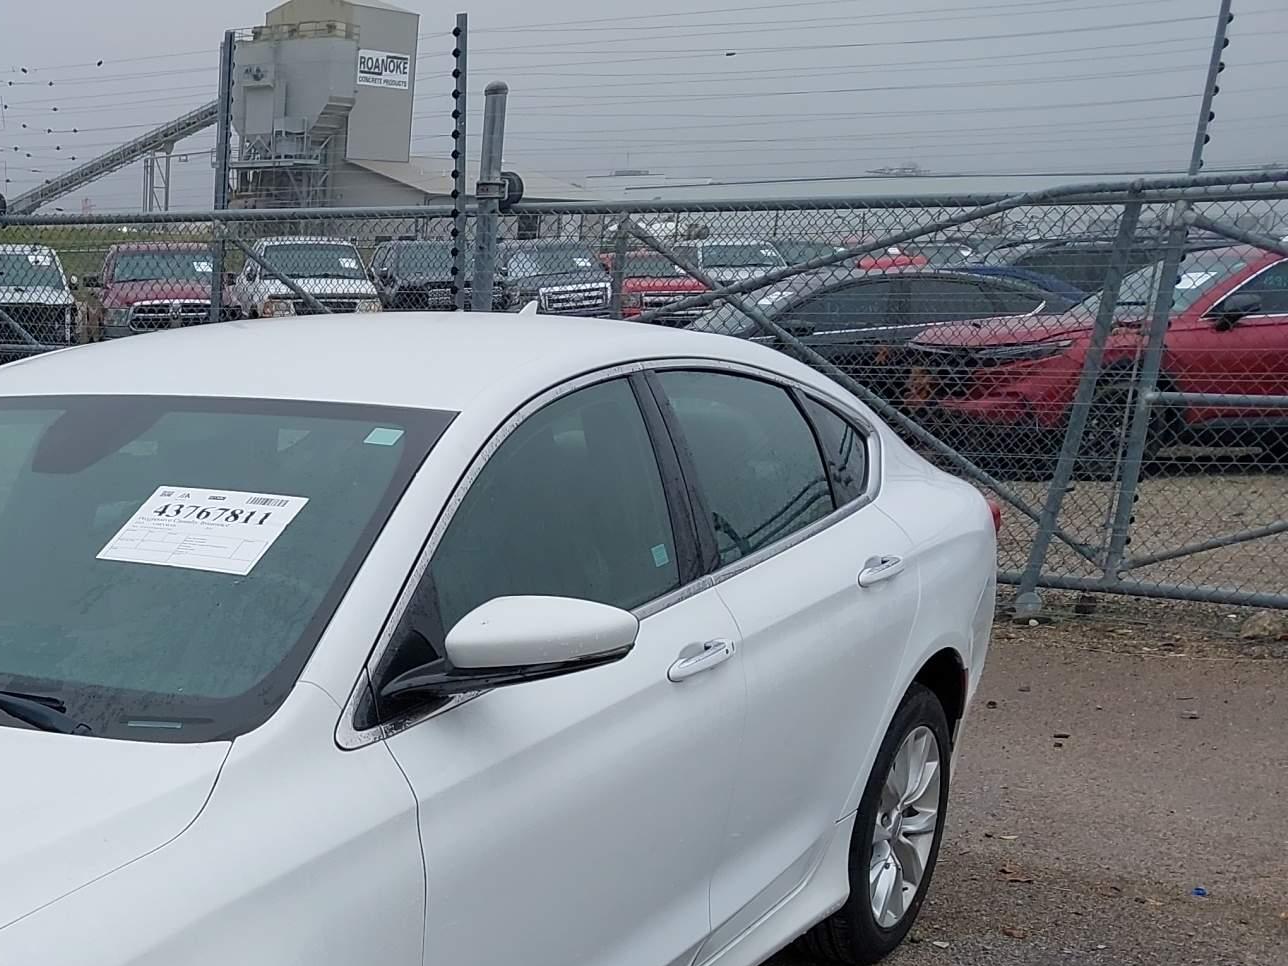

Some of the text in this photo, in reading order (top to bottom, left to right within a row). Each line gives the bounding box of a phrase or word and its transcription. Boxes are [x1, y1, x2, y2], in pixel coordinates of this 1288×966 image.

[359, 55, 409, 76] ROANOKE
[358, 75, 407, 88] CONCRETE PRODUCTS
[153, 503, 272, 525] 43767811
